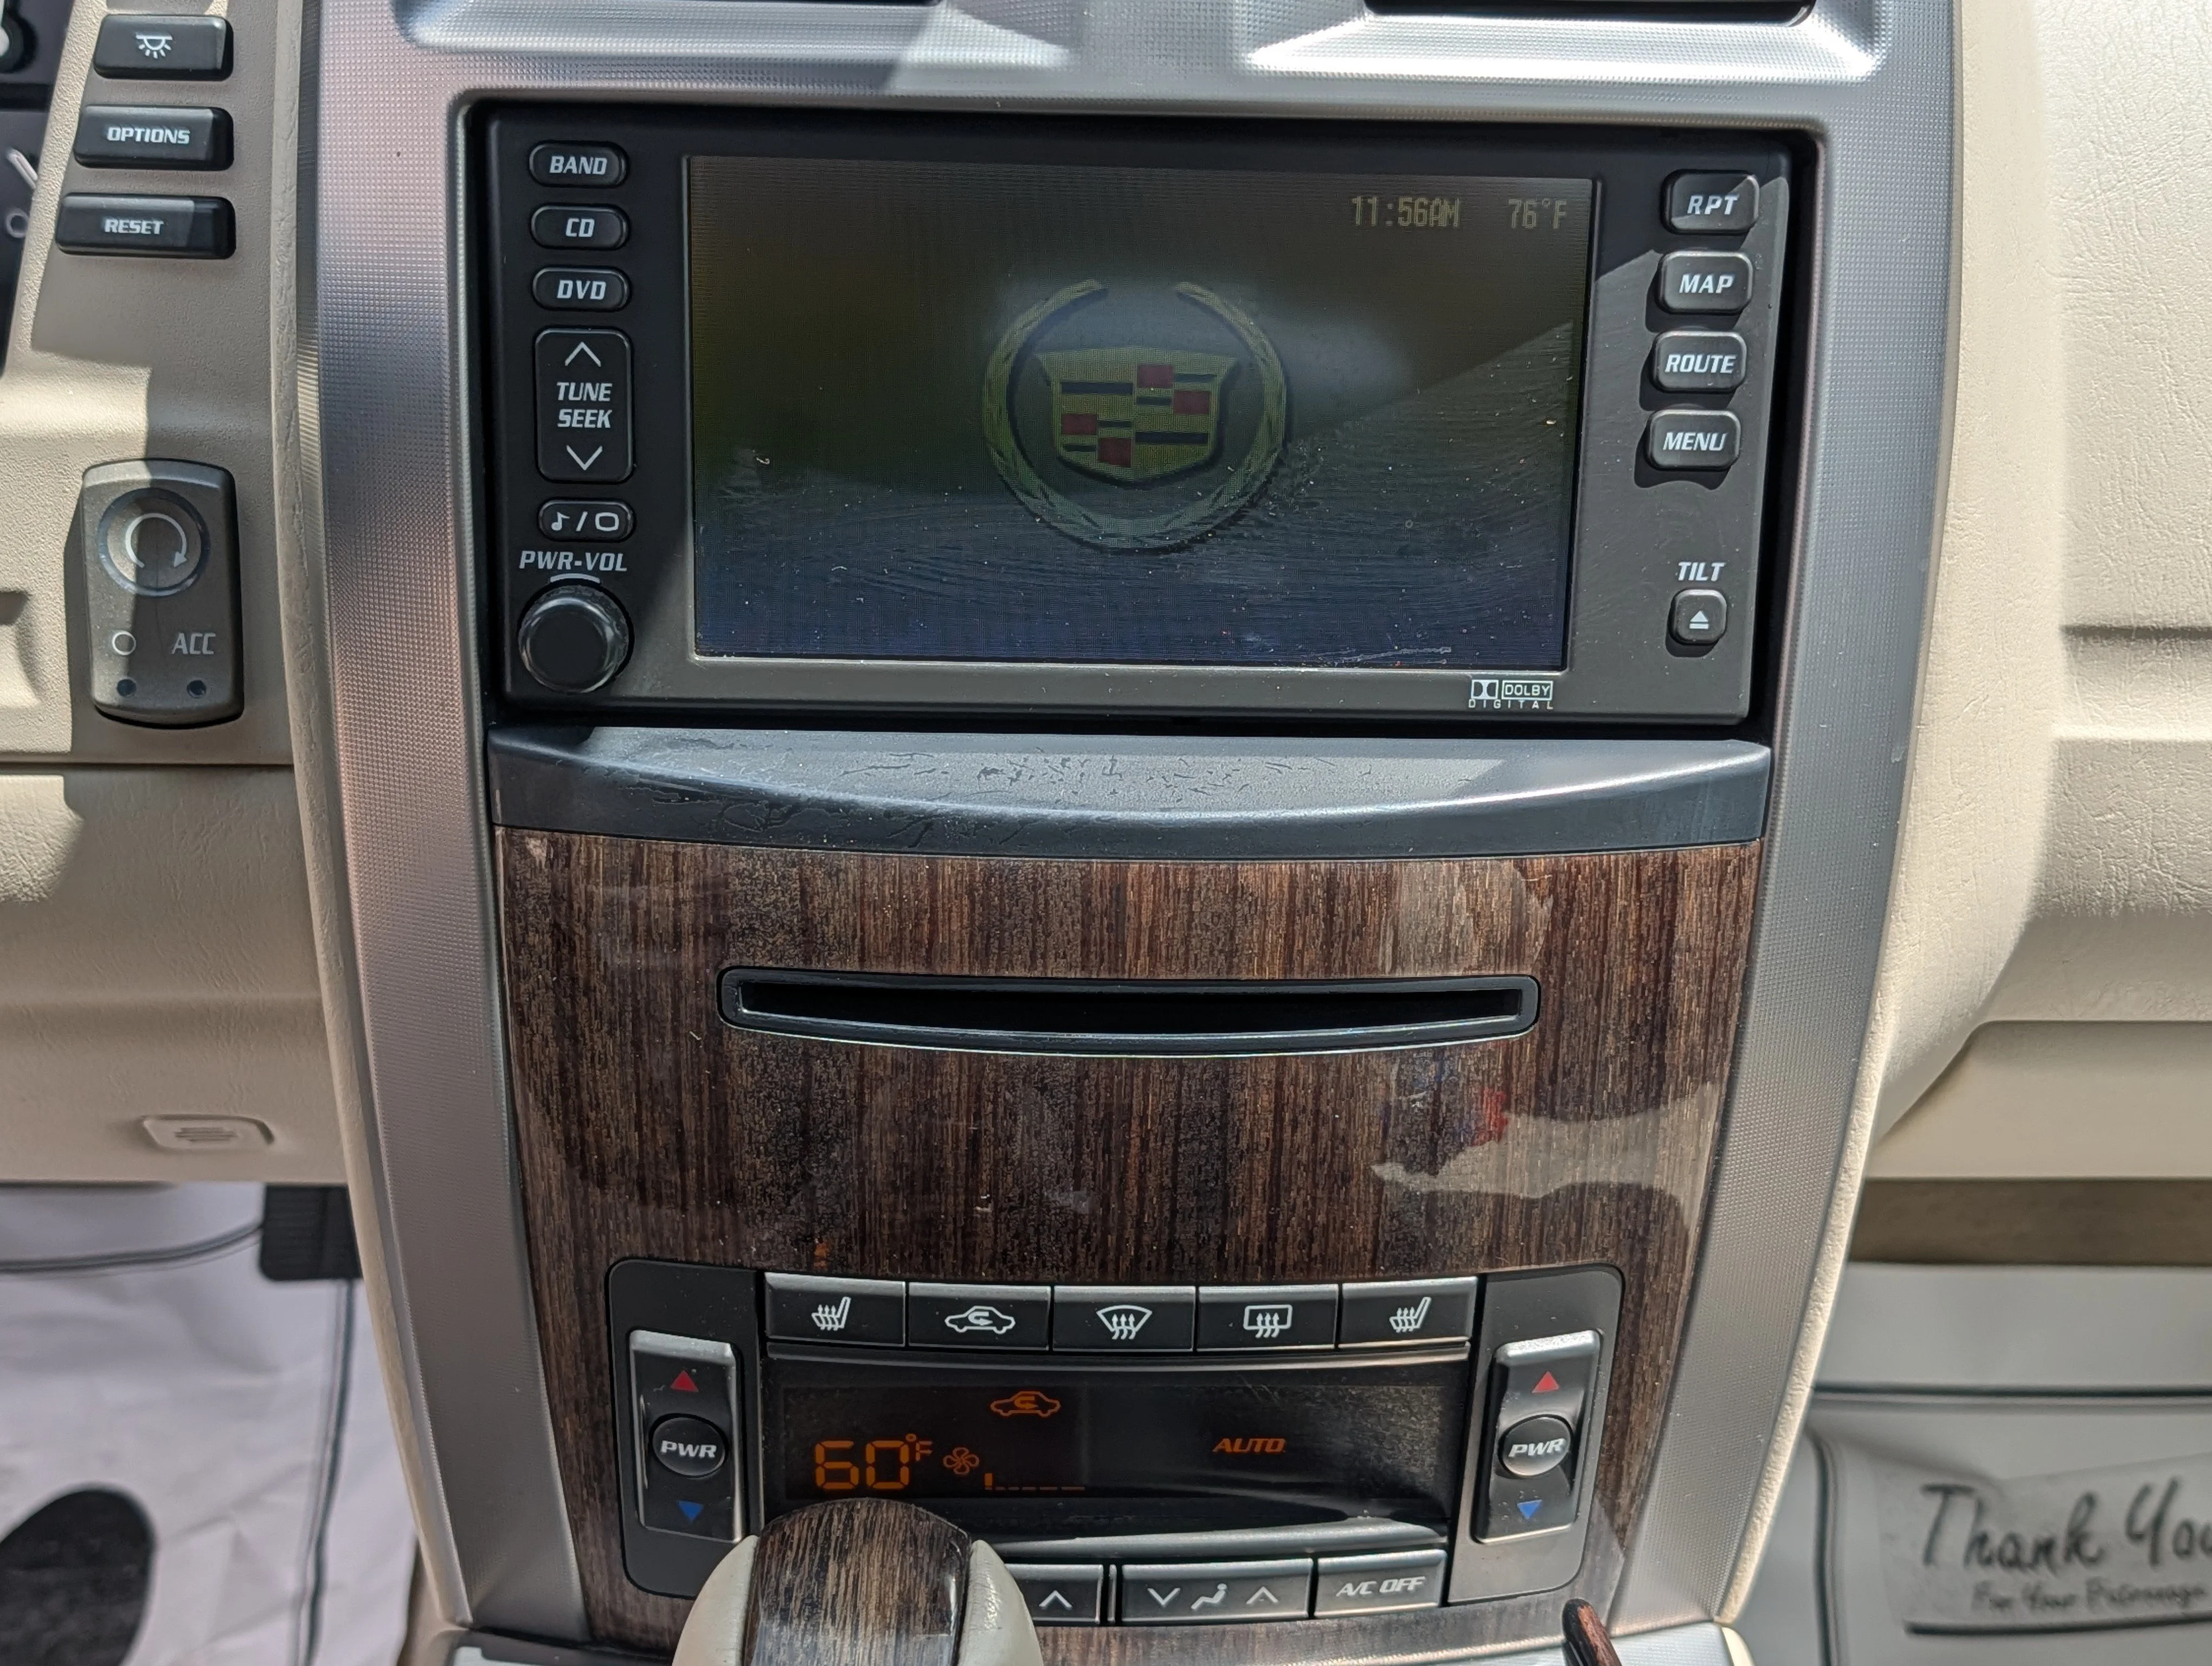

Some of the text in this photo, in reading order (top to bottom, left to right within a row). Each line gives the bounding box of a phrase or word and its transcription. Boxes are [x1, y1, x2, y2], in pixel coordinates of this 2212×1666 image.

[107, 126, 190, 144] OPTIONS
[549, 156, 608, 175] BAND
[1687, 194, 1738, 215] RPT
[104, 219, 164, 235] RESET
[565, 218, 595, 238] CD
[557, 280, 606, 300] DVD
[1679, 274, 1733, 293] MAP
[1664, 354, 1735, 374] ROUTE
[557, 382, 612, 401] TUNE
[557, 409, 612, 428] SEEK
[1662, 432, 1727, 451] MENU
[519, 550, 627, 572] PWR-VOL
[1678, 561, 1725, 581] TILT
[172, 632, 216, 655] ACC
[1504, 684, 1551, 696] DOLBY
[1468, 699, 1554, 709] DIGITAL
[660, 1439, 717, 1458] PWR
[1212, 1438, 1285, 1453] AUTO
[1508, 1438, 1566, 1458] PWR
[1921, 1483, 2105, 1573] Thank
[1379, 1576, 1426, 1593] OFF
